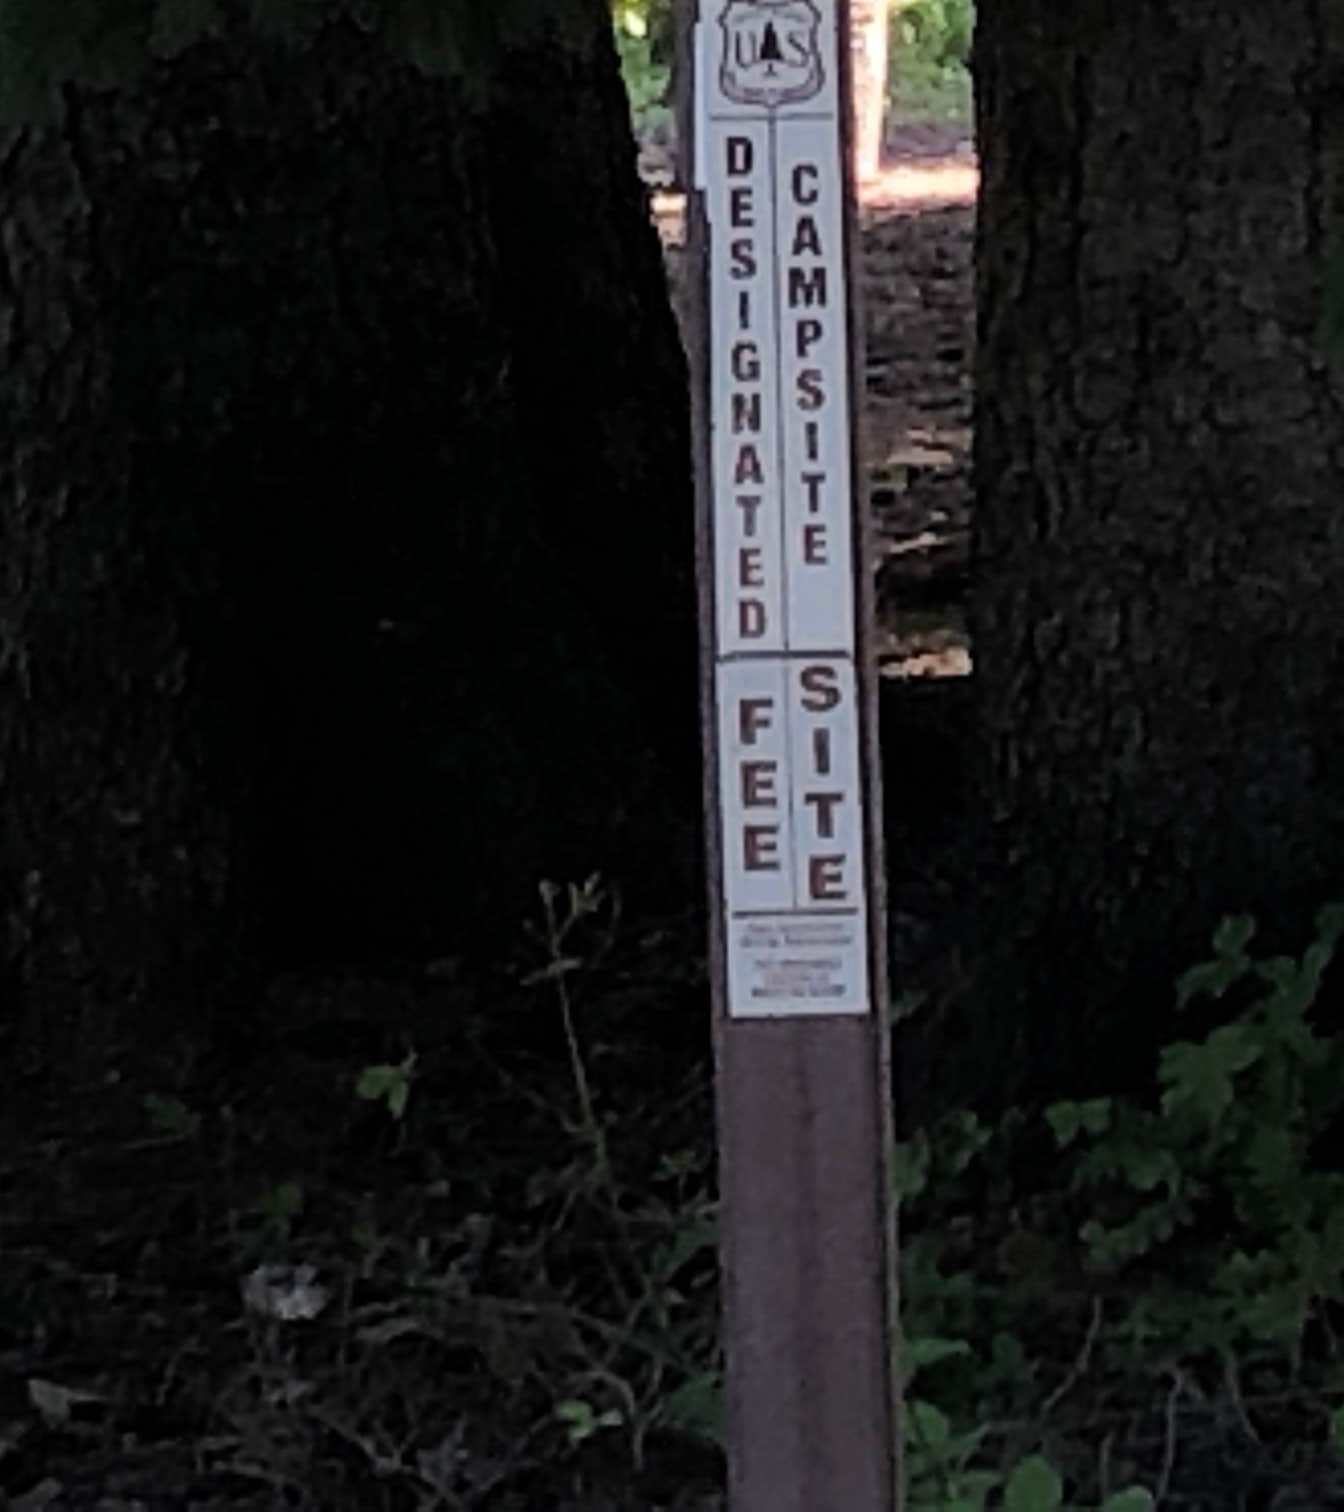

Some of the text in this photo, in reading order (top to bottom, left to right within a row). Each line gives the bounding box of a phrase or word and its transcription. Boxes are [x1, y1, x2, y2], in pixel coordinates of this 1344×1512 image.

[725, 135, 766, 639] DESIGNATED
[787, 163, 828, 566] CAMPSITE
[739, 698, 780, 871] FEE
[800, 665, 847, 900] SITE
